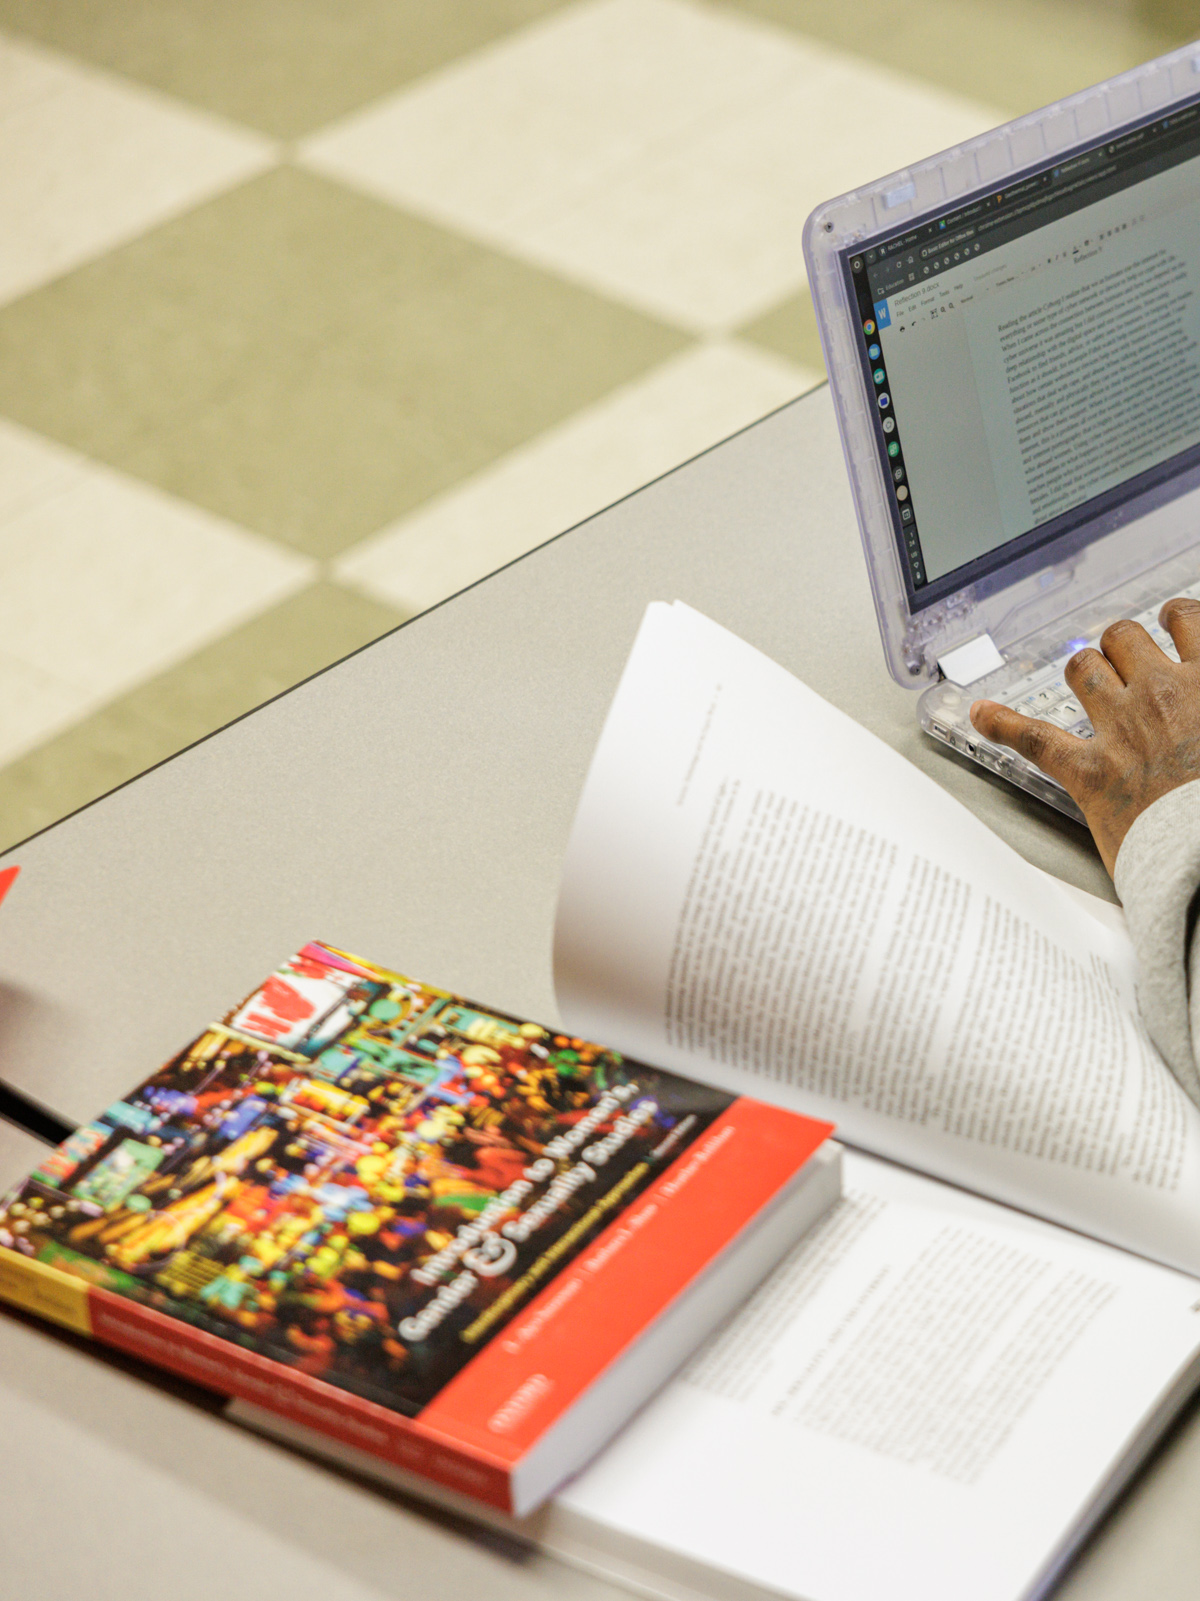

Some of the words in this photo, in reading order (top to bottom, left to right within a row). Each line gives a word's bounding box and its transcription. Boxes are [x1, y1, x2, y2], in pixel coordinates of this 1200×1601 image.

[893, 289, 921, 307] Reflection
[398, 1270, 478, 1341] Gender
[463, 1230, 518, 1277] &
[502, 1161, 597, 1243] Sexuality
[581, 1100, 658, 1166] Studies
[410, 1179, 533, 1285] Introduction
[523, 1158, 555, 1182] to
[542, 1083, 640, 1159] Women's,
